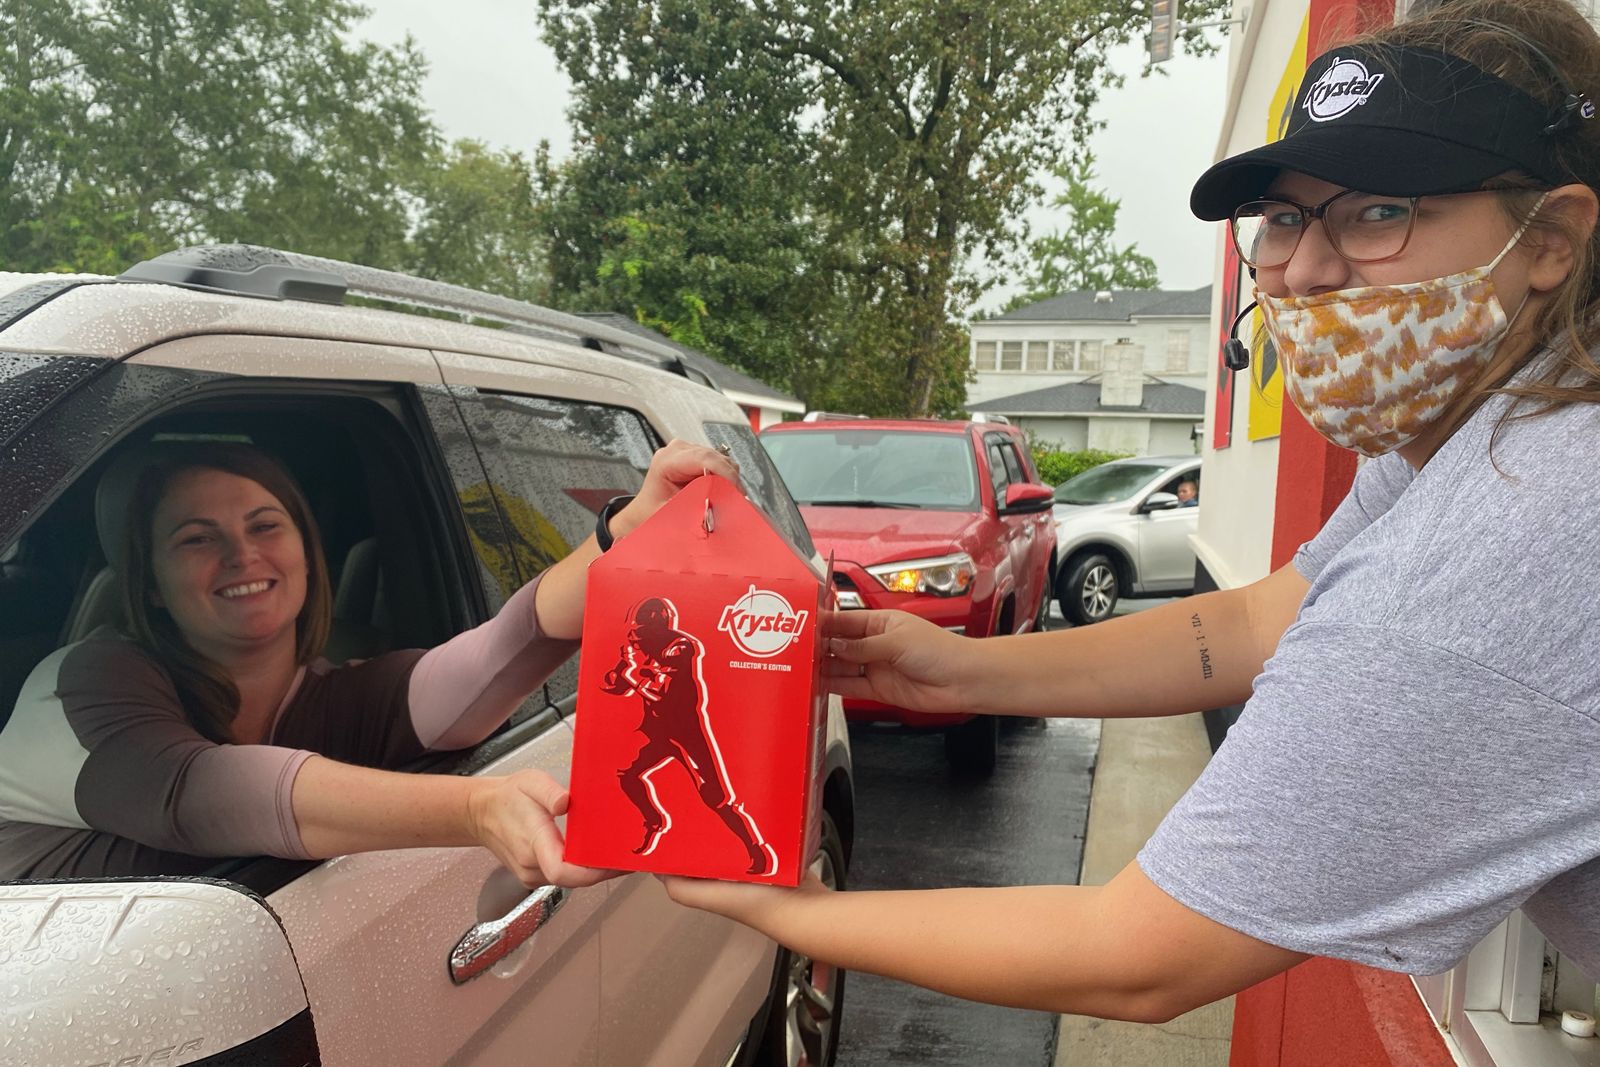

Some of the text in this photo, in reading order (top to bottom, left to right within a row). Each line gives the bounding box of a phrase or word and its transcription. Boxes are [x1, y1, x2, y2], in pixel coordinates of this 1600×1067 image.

[1303, 73, 1384, 109] Krystal
[718, 605, 808, 638] Krystal
[729, 660, 792, 672] COLLECTOR'S EDITION
